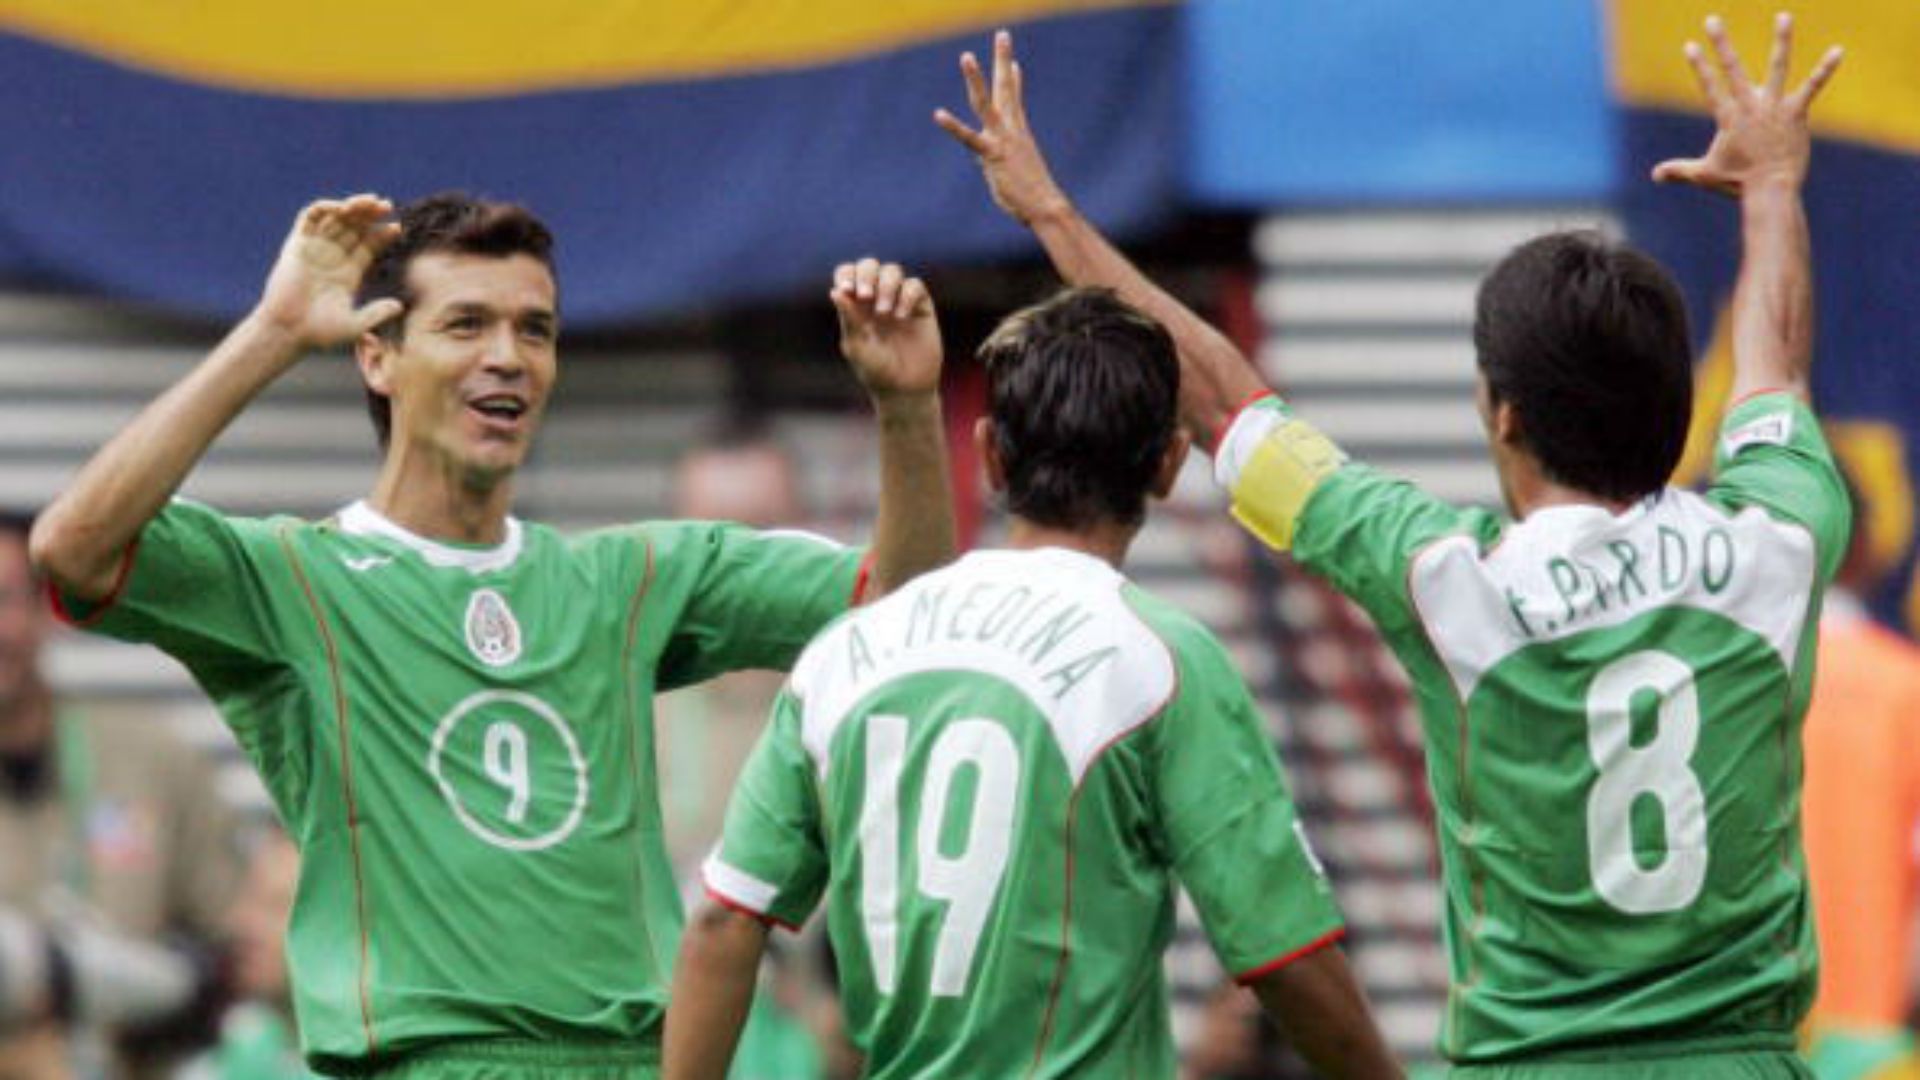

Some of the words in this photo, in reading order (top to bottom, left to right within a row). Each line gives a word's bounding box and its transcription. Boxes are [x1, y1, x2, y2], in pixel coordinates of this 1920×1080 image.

[483, 721, 530, 824] 9
[859, 714, 1019, 998] 19
[1586, 649, 1708, 915] 8
